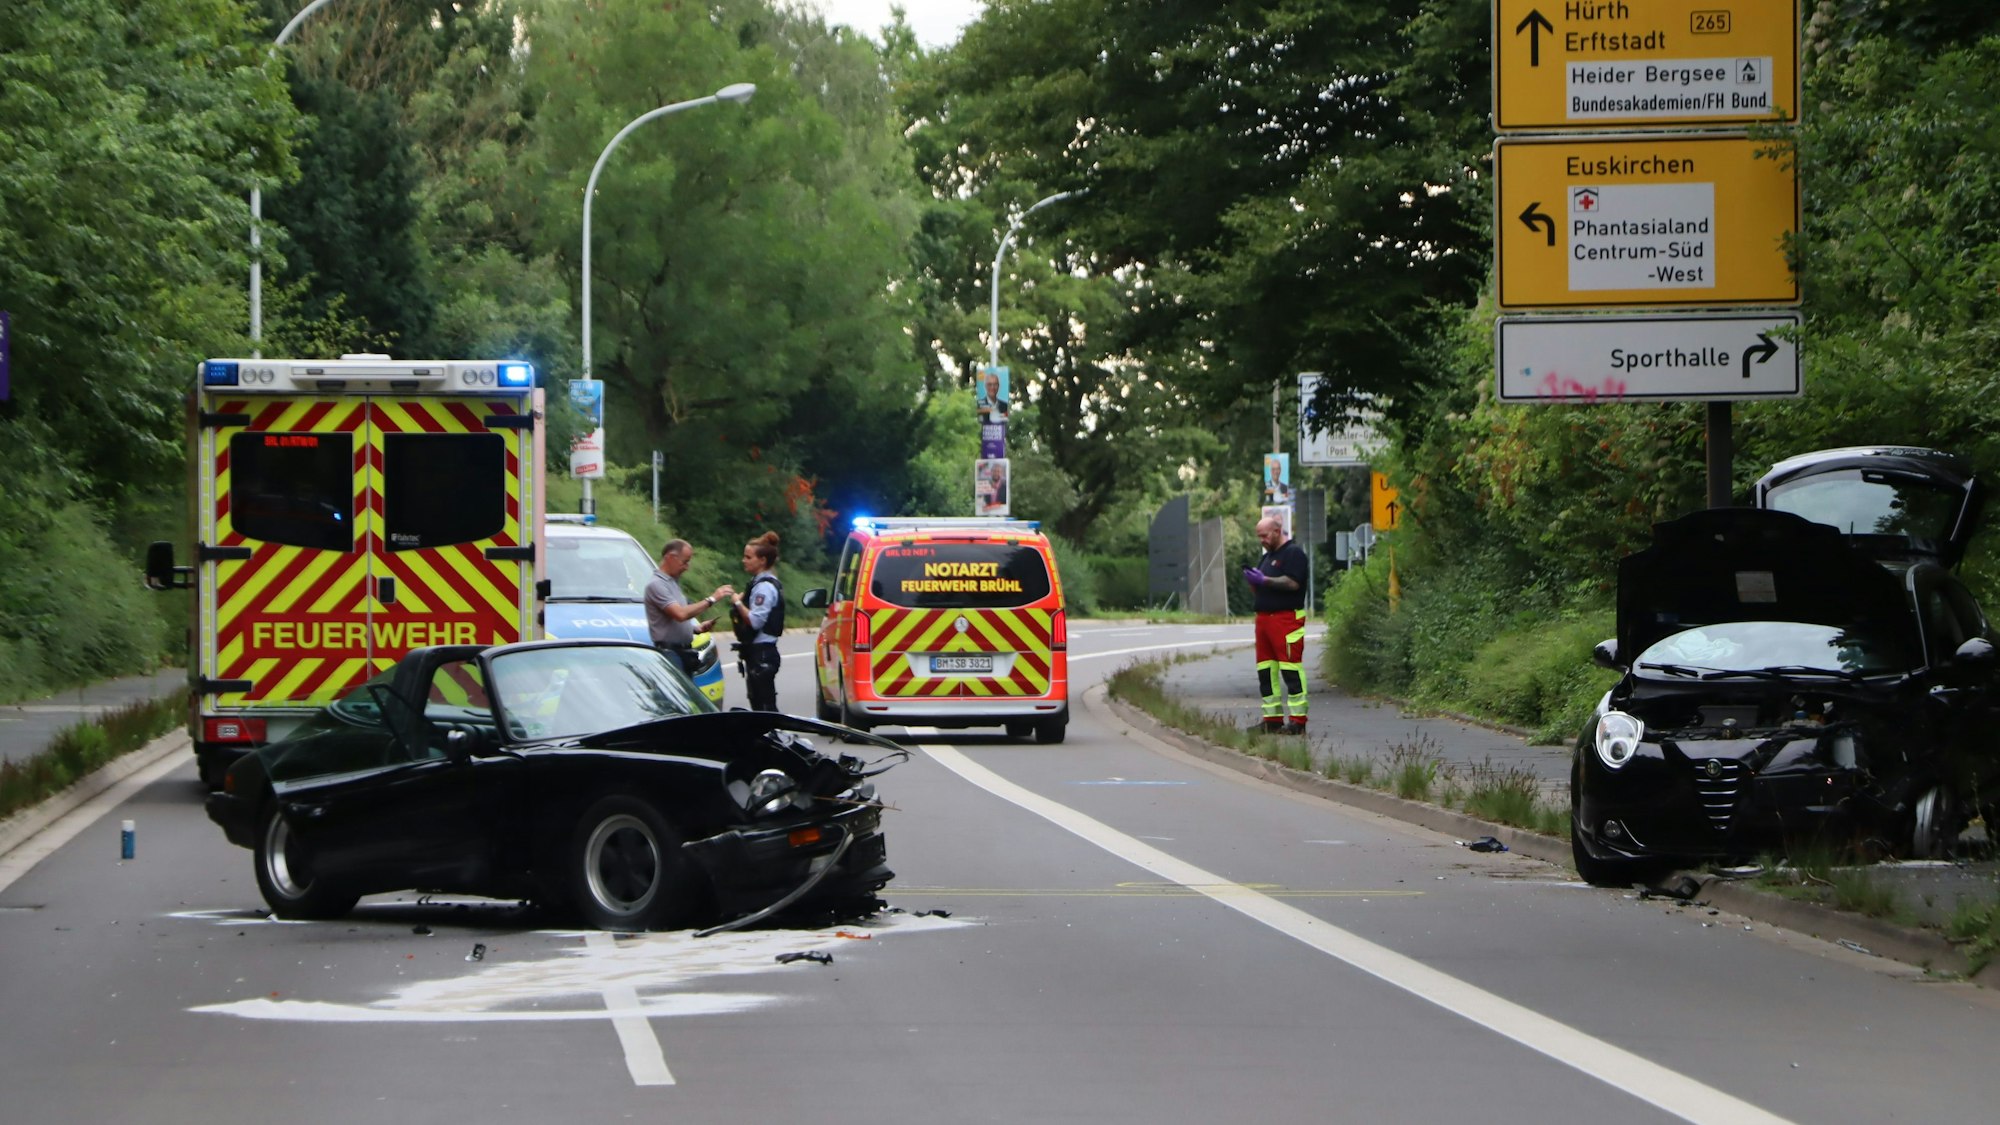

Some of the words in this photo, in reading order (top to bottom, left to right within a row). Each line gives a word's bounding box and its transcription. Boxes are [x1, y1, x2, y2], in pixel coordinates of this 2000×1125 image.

[1565, 1, 1629, 20] Hürth
[1695, 15, 1726, 30] 265
[1565, 31, 1666, 51] Erftstadt
[1571, 66, 1635, 84] Heider
[1646, 66, 1726, 86] Bergsee
[1572, 93, 1724, 113] Bundesakademien/FH
[1732, 91, 1767, 109] Bund
[1567, 156, 1694, 176] Euskirchen
[1574, 218, 1709, 236] Phantasialand
[1574, 242, 1703, 260] Centrum-Süd
[1648, 266, 1704, 282] -West
[1611, 348, 1730, 372] Sporthalle
[924, 562, 999, 577] NOTARZT
[901, 580, 978, 592] FEUERWEHR
[980, 578, 1023, 592] BRÜHL
[253, 621, 477, 649] FEUERWEHR
[936, 658, 949, 668] BM
[968, 658, 991, 668] 3821
